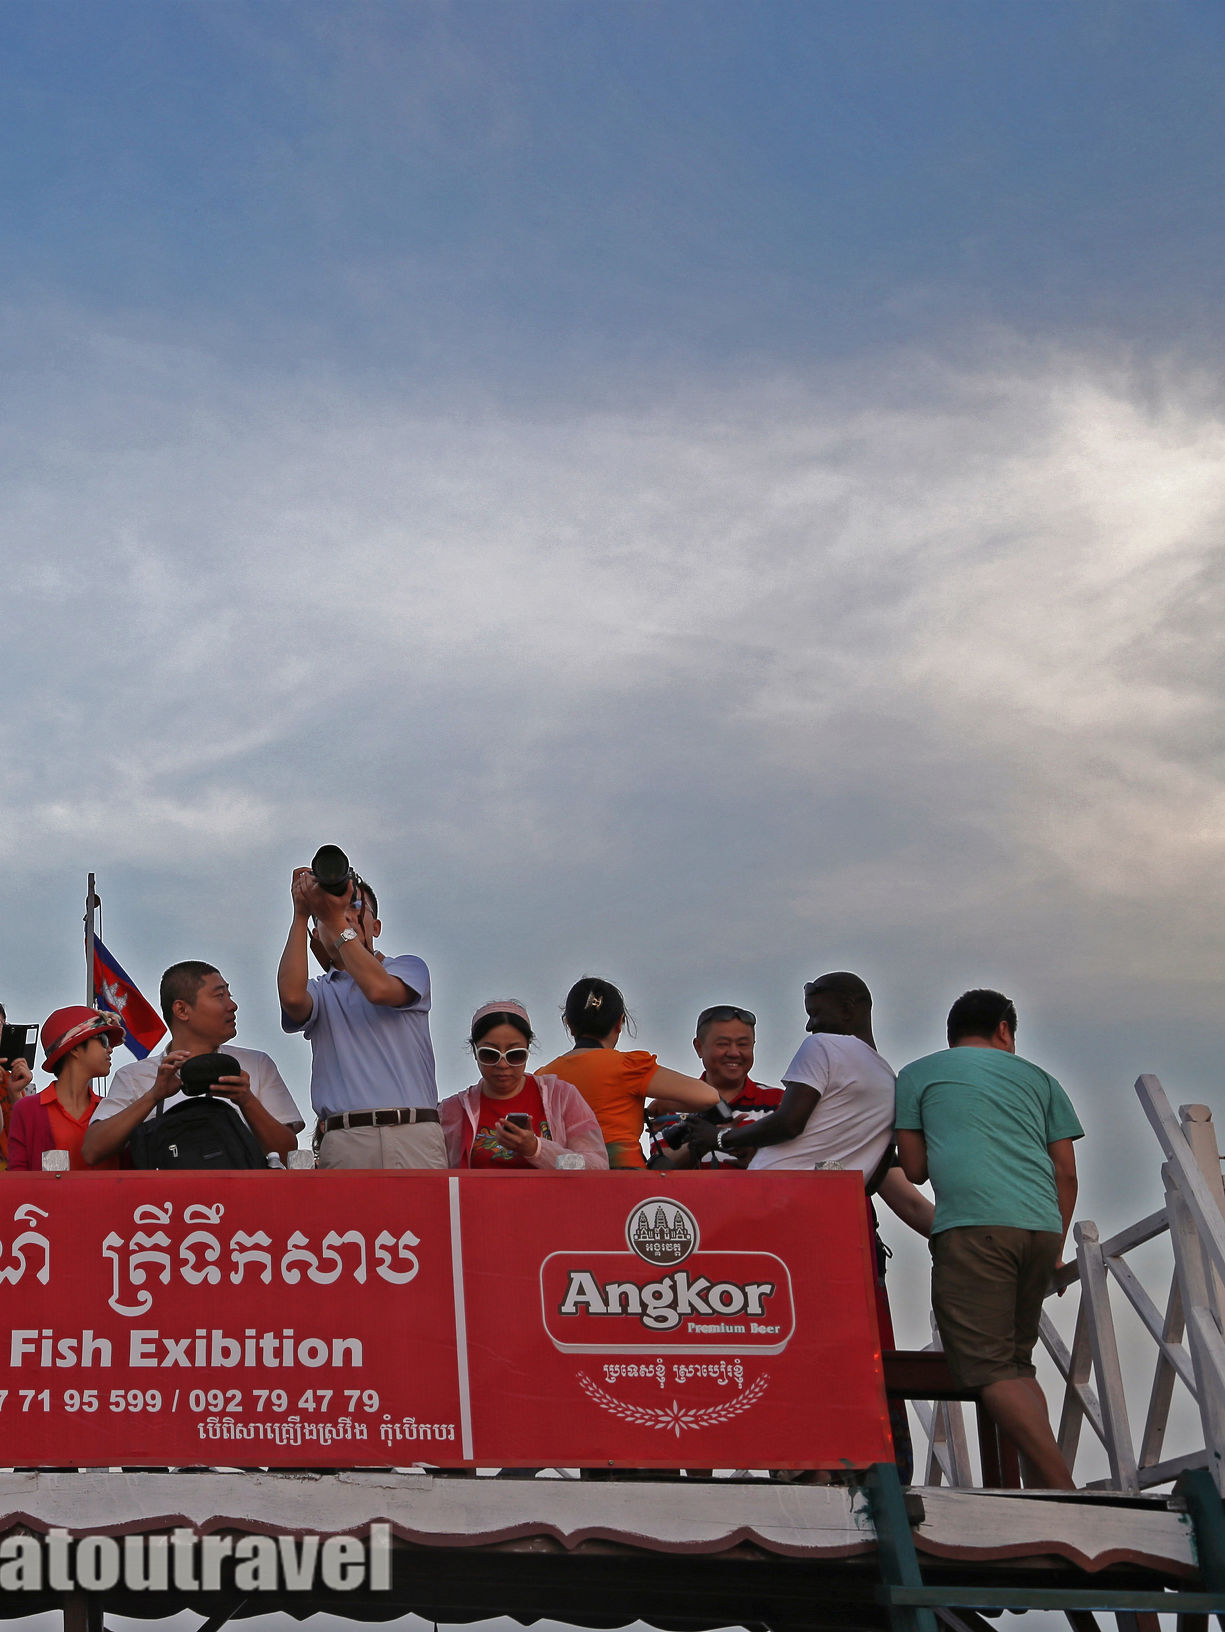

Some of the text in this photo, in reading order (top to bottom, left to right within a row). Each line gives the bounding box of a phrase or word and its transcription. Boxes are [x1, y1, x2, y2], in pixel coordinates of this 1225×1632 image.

[102, 1201, 421, 1317] ត្រីទឹកសាប
[560, 1271, 775, 1331] Angkor
[9, 1328, 113, 1368] Fish
[128, 1328, 363, 1368] Exibition
[687, 1322, 781, 1334] Premium Beer
[18, 1390, 51, 1412] 71
[63, 1390, 99, 1413] 95
[109, 1390, 163, 1413] 599
[188, 1390, 243, 1413] 092
[252, 1390, 288, 1413] 79
[297, 1390, 334, 1413] 47
[343, 1390, 380, 1413] 79
